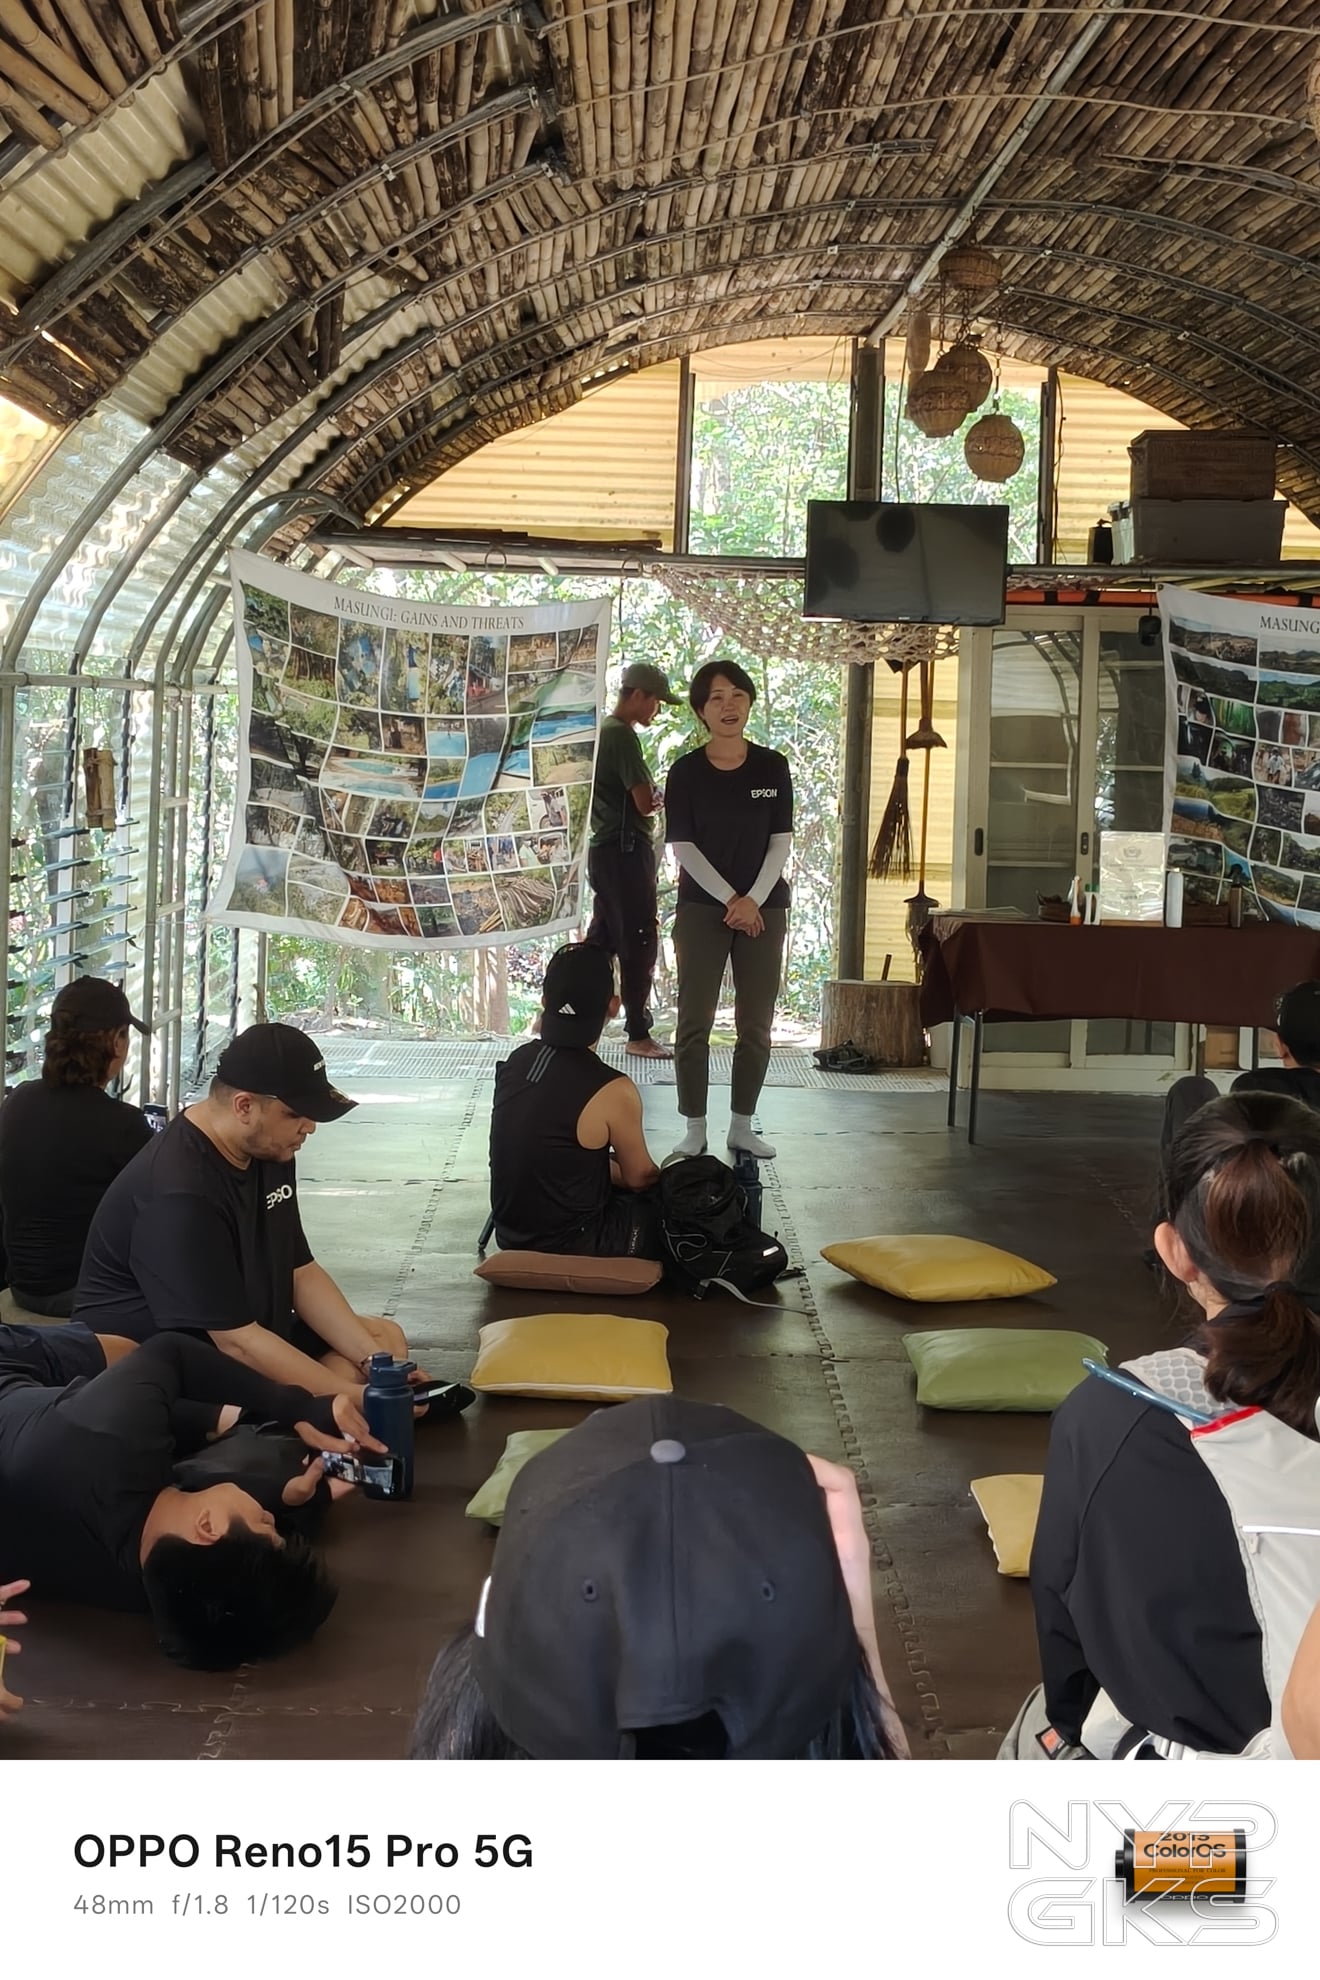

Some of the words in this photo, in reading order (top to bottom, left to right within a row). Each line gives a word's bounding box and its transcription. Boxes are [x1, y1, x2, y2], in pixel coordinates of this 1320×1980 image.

[333, 596, 397, 622] MASUNGI:
[400, 610, 438, 627] GAINS
[440, 615, 468, 629] AND
[470, 616, 525, 630] THREATS
[1260, 615, 1320, 634] MASUNG
[750, 788, 777, 798] EPSON
